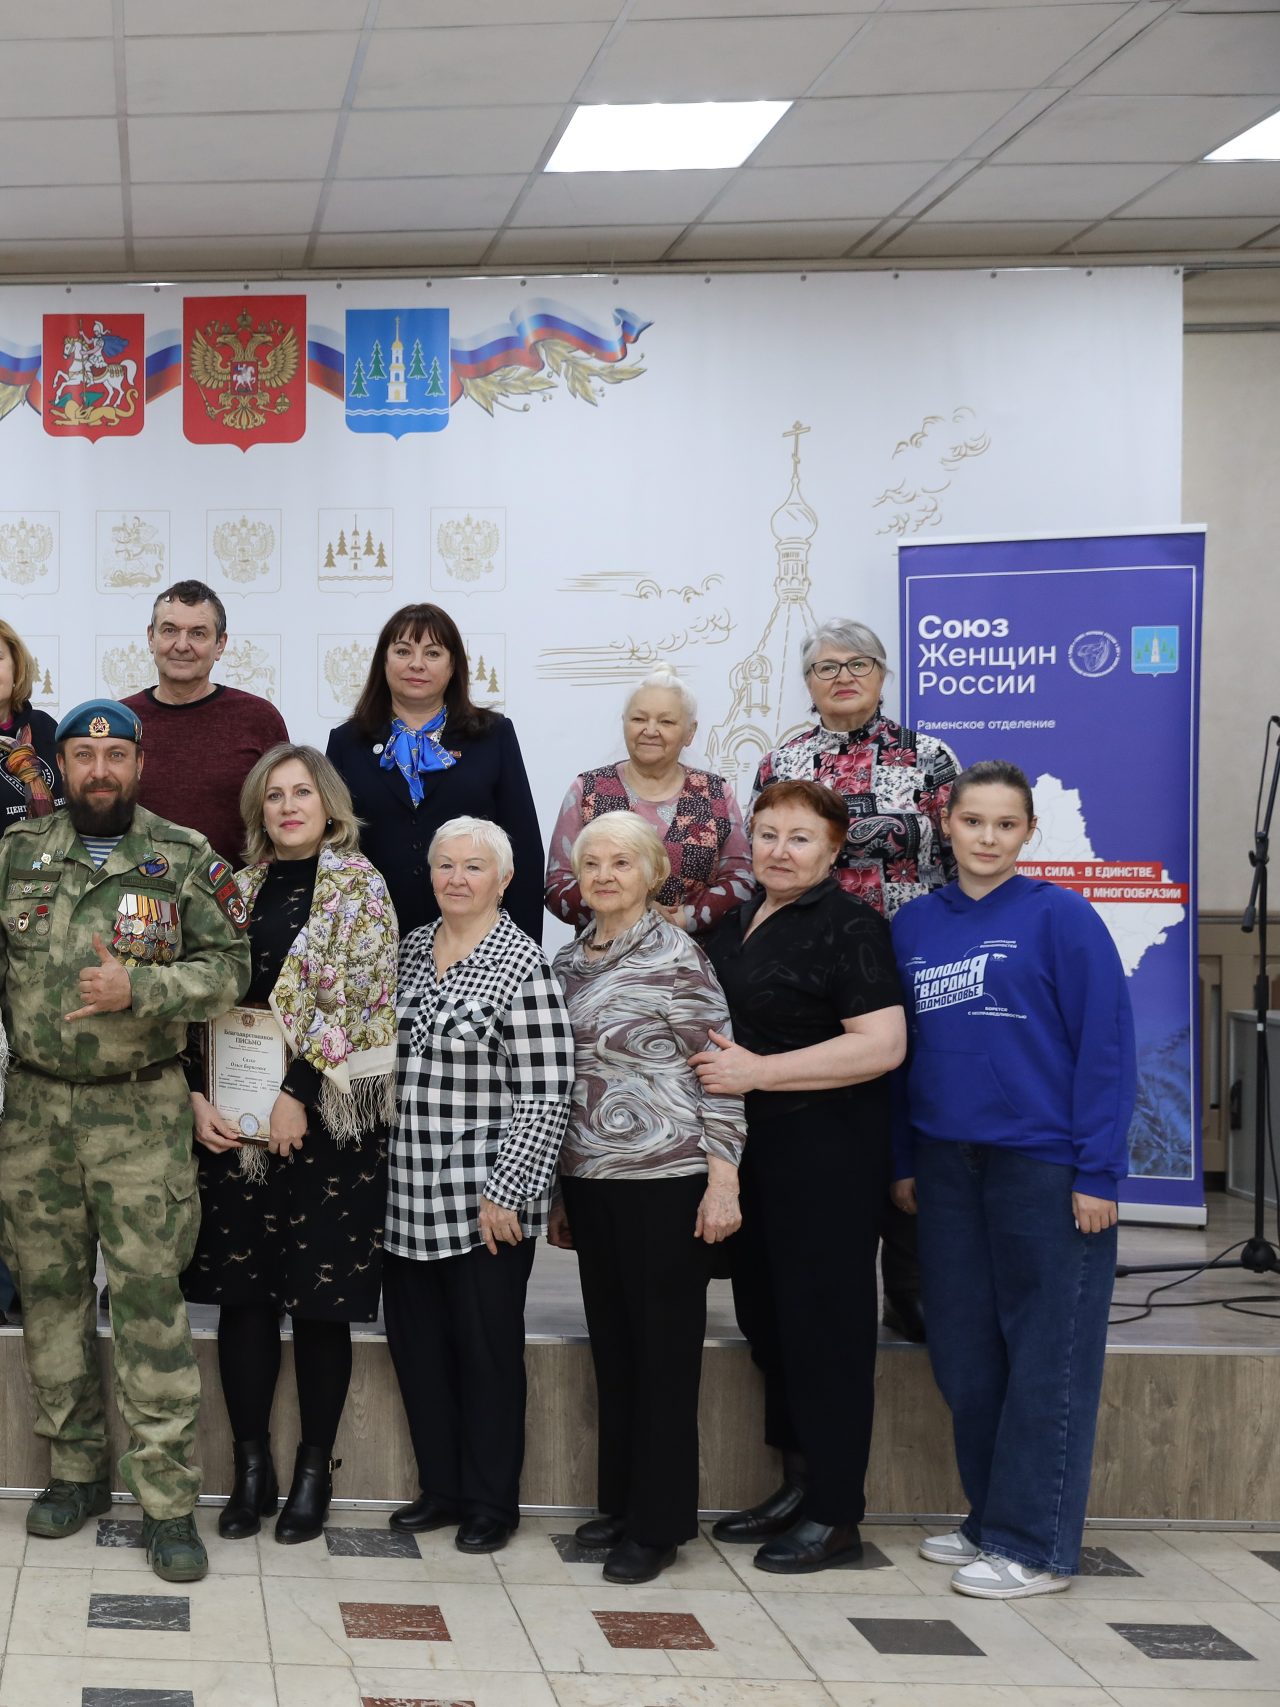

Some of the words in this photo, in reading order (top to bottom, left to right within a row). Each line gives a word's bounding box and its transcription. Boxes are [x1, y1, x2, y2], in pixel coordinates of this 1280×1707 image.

[917, 614, 1009, 640] Союз
[917, 643, 1057, 670] Женщин
[918, 672, 1036, 696] России
[917, 719, 985, 731] Раменское
[988, 718, 1056, 731] отделение
[1045, 866, 1075, 877] СИЛА
[1084, 866, 1093, 878] В
[1095, 866, 1156, 879] ЕДИНСТВЕ,
[1082, 887, 1091, 898] В
[1093, 887, 1181, 899] МНОГООБРАЗИИ
[914, 953, 989, 984] МОЛОДАЯ
